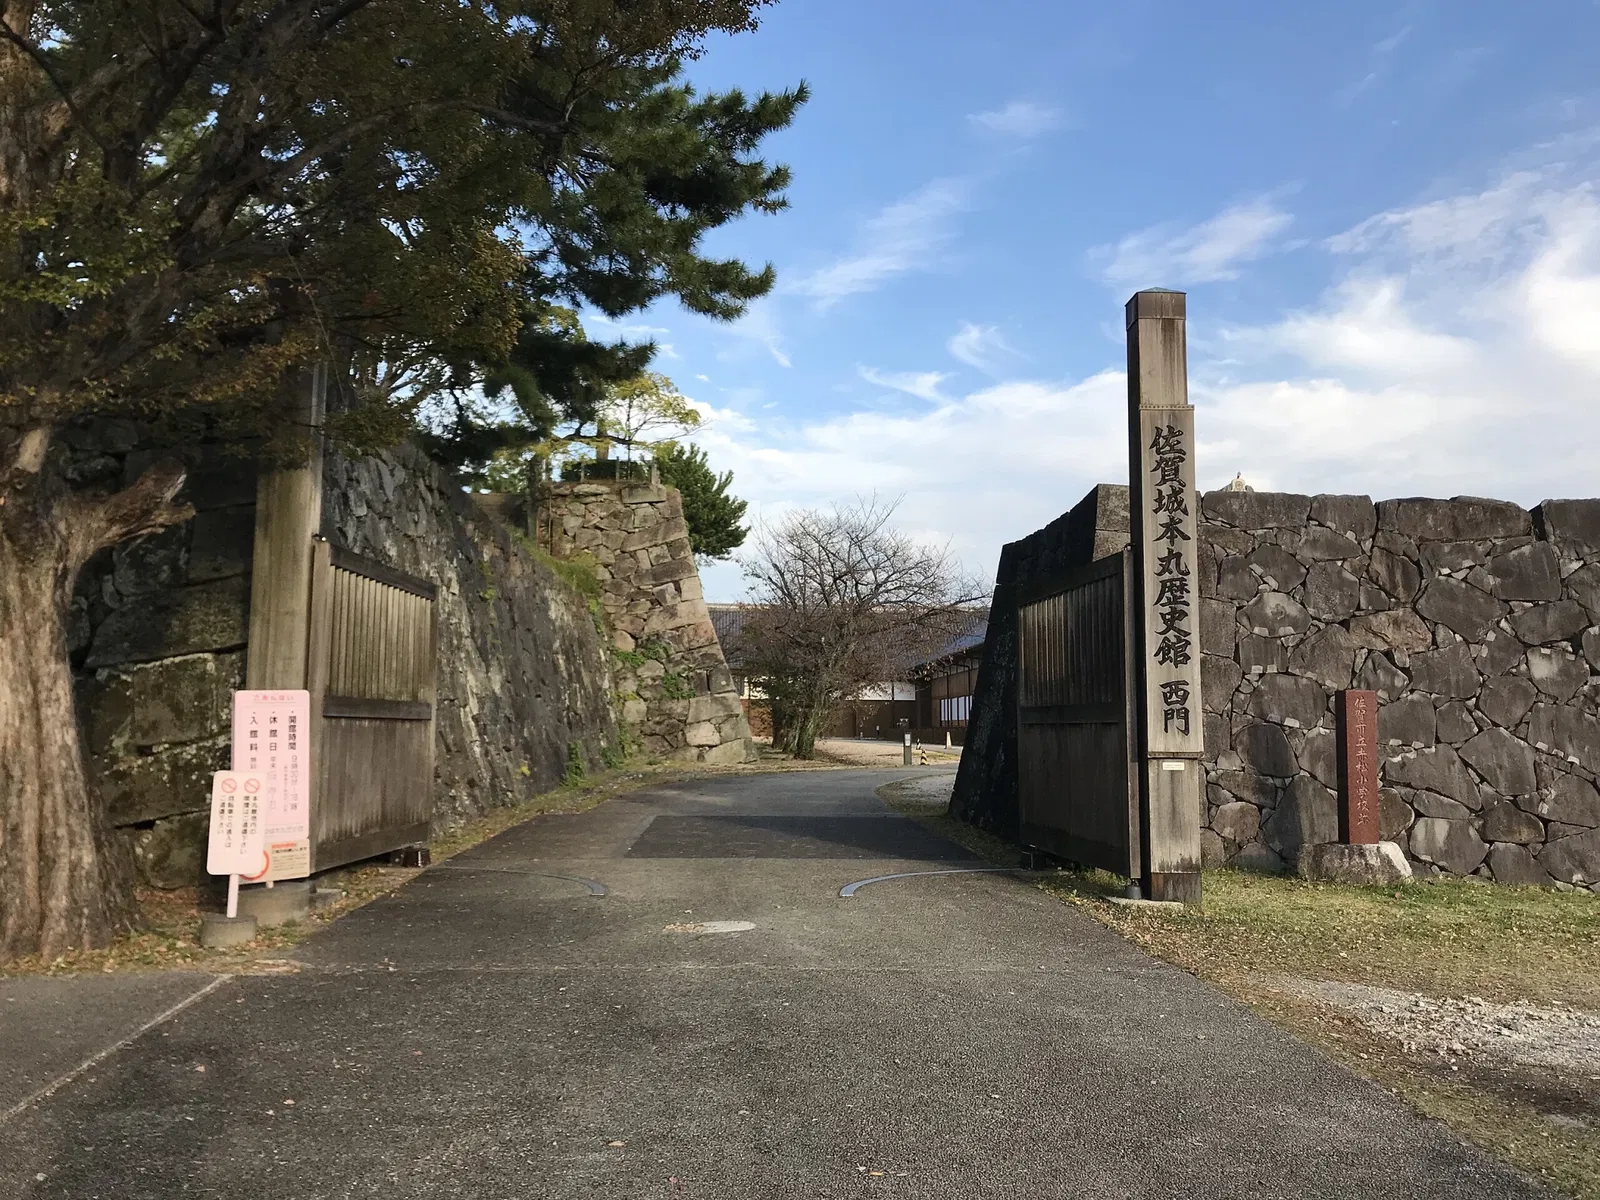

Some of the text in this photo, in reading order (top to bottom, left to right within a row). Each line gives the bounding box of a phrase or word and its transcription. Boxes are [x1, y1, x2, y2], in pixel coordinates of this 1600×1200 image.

[1149, 425, 1193, 669] 佐賀城本丸歴史館
[249, 716, 259, 752] 入館料
[269, 715, 278, 751] 休館日
[1159, 680, 1190, 737] 西門
[1354, 696, 1371, 825] 佐賀市立赤松小学校跡
